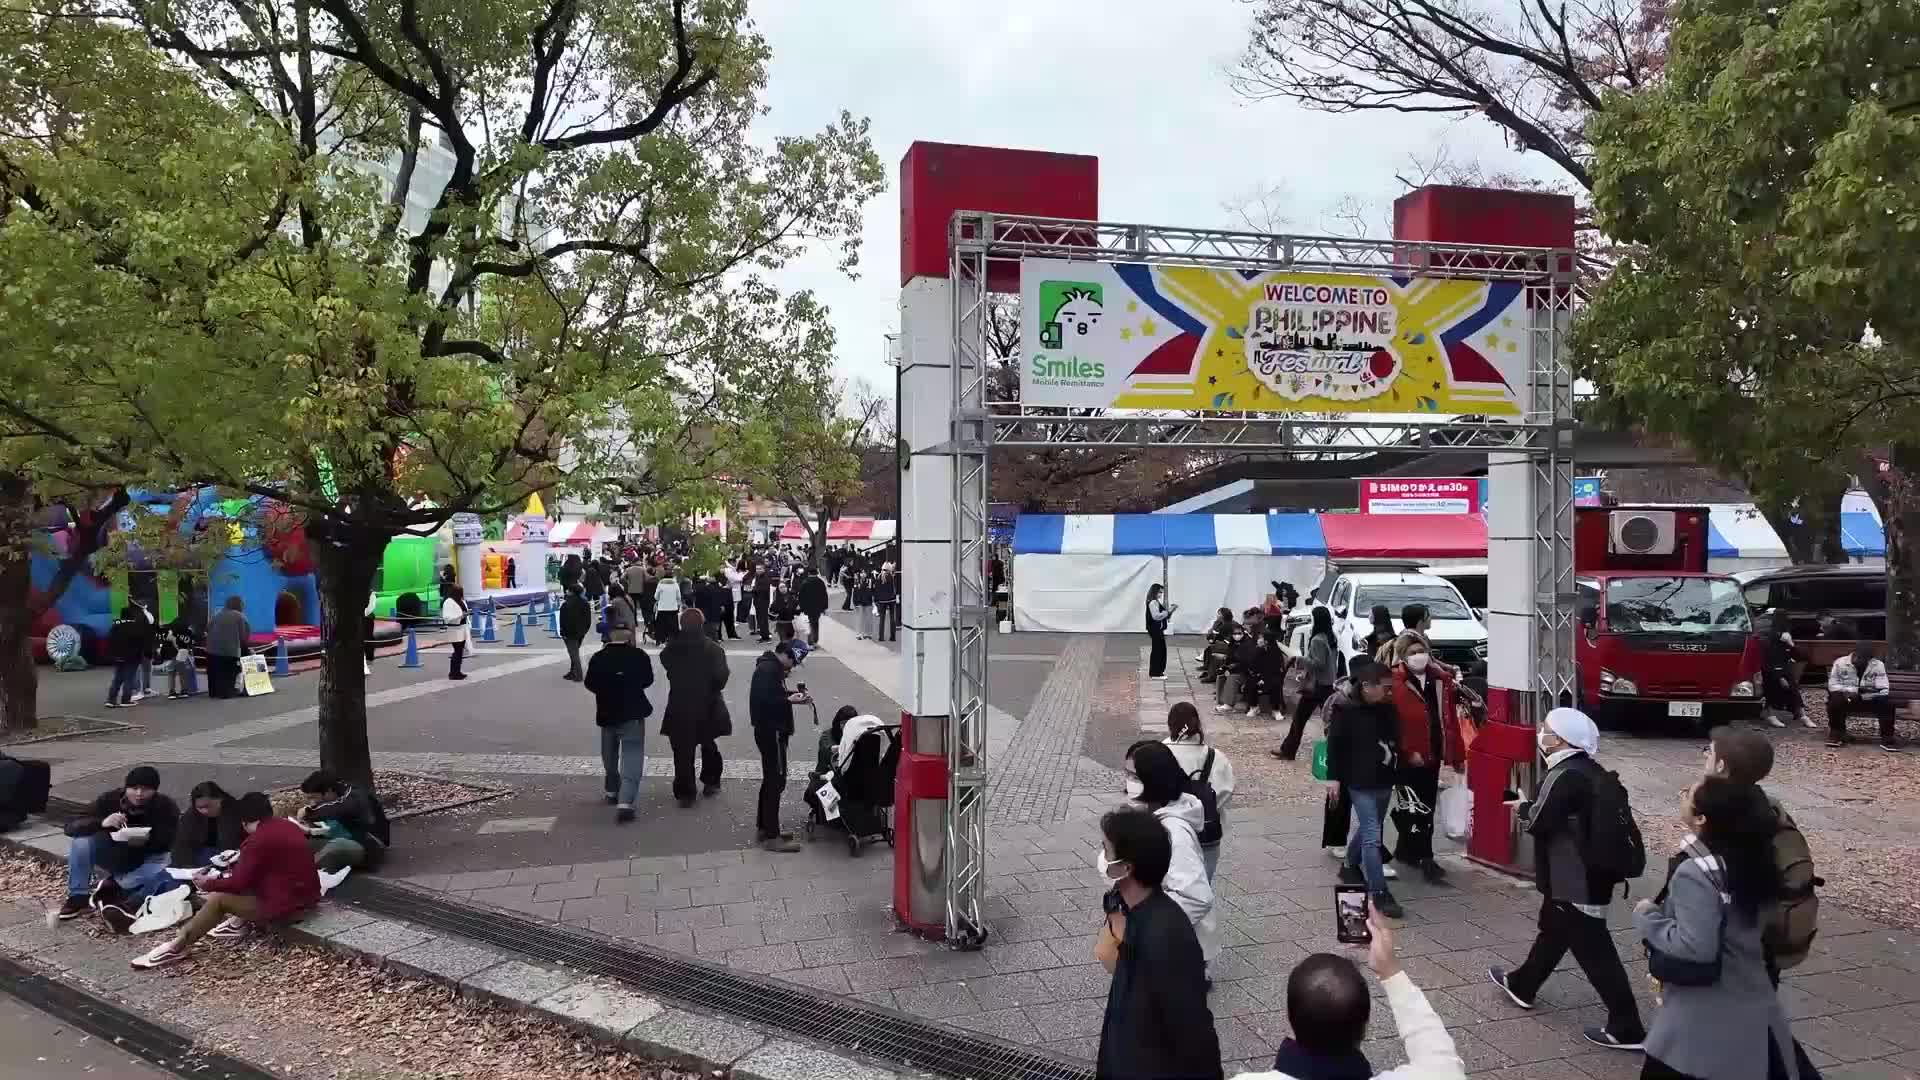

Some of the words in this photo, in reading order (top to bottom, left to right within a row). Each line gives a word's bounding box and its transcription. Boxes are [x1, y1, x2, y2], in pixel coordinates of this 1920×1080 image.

[1265, 285, 1358, 304] WELCOME
[1363, 289, 1387, 305] TO
[1255, 307, 1392, 334] PHILIPPINE
[1032, 354, 1104, 378] Smiles
[1260, 350, 1363, 375] Festival
[1032, 378, 1059, 386] Mobile
[1060, 379, 1104, 387] Remittance
[1668, 643, 1708, 652] ISUZU
